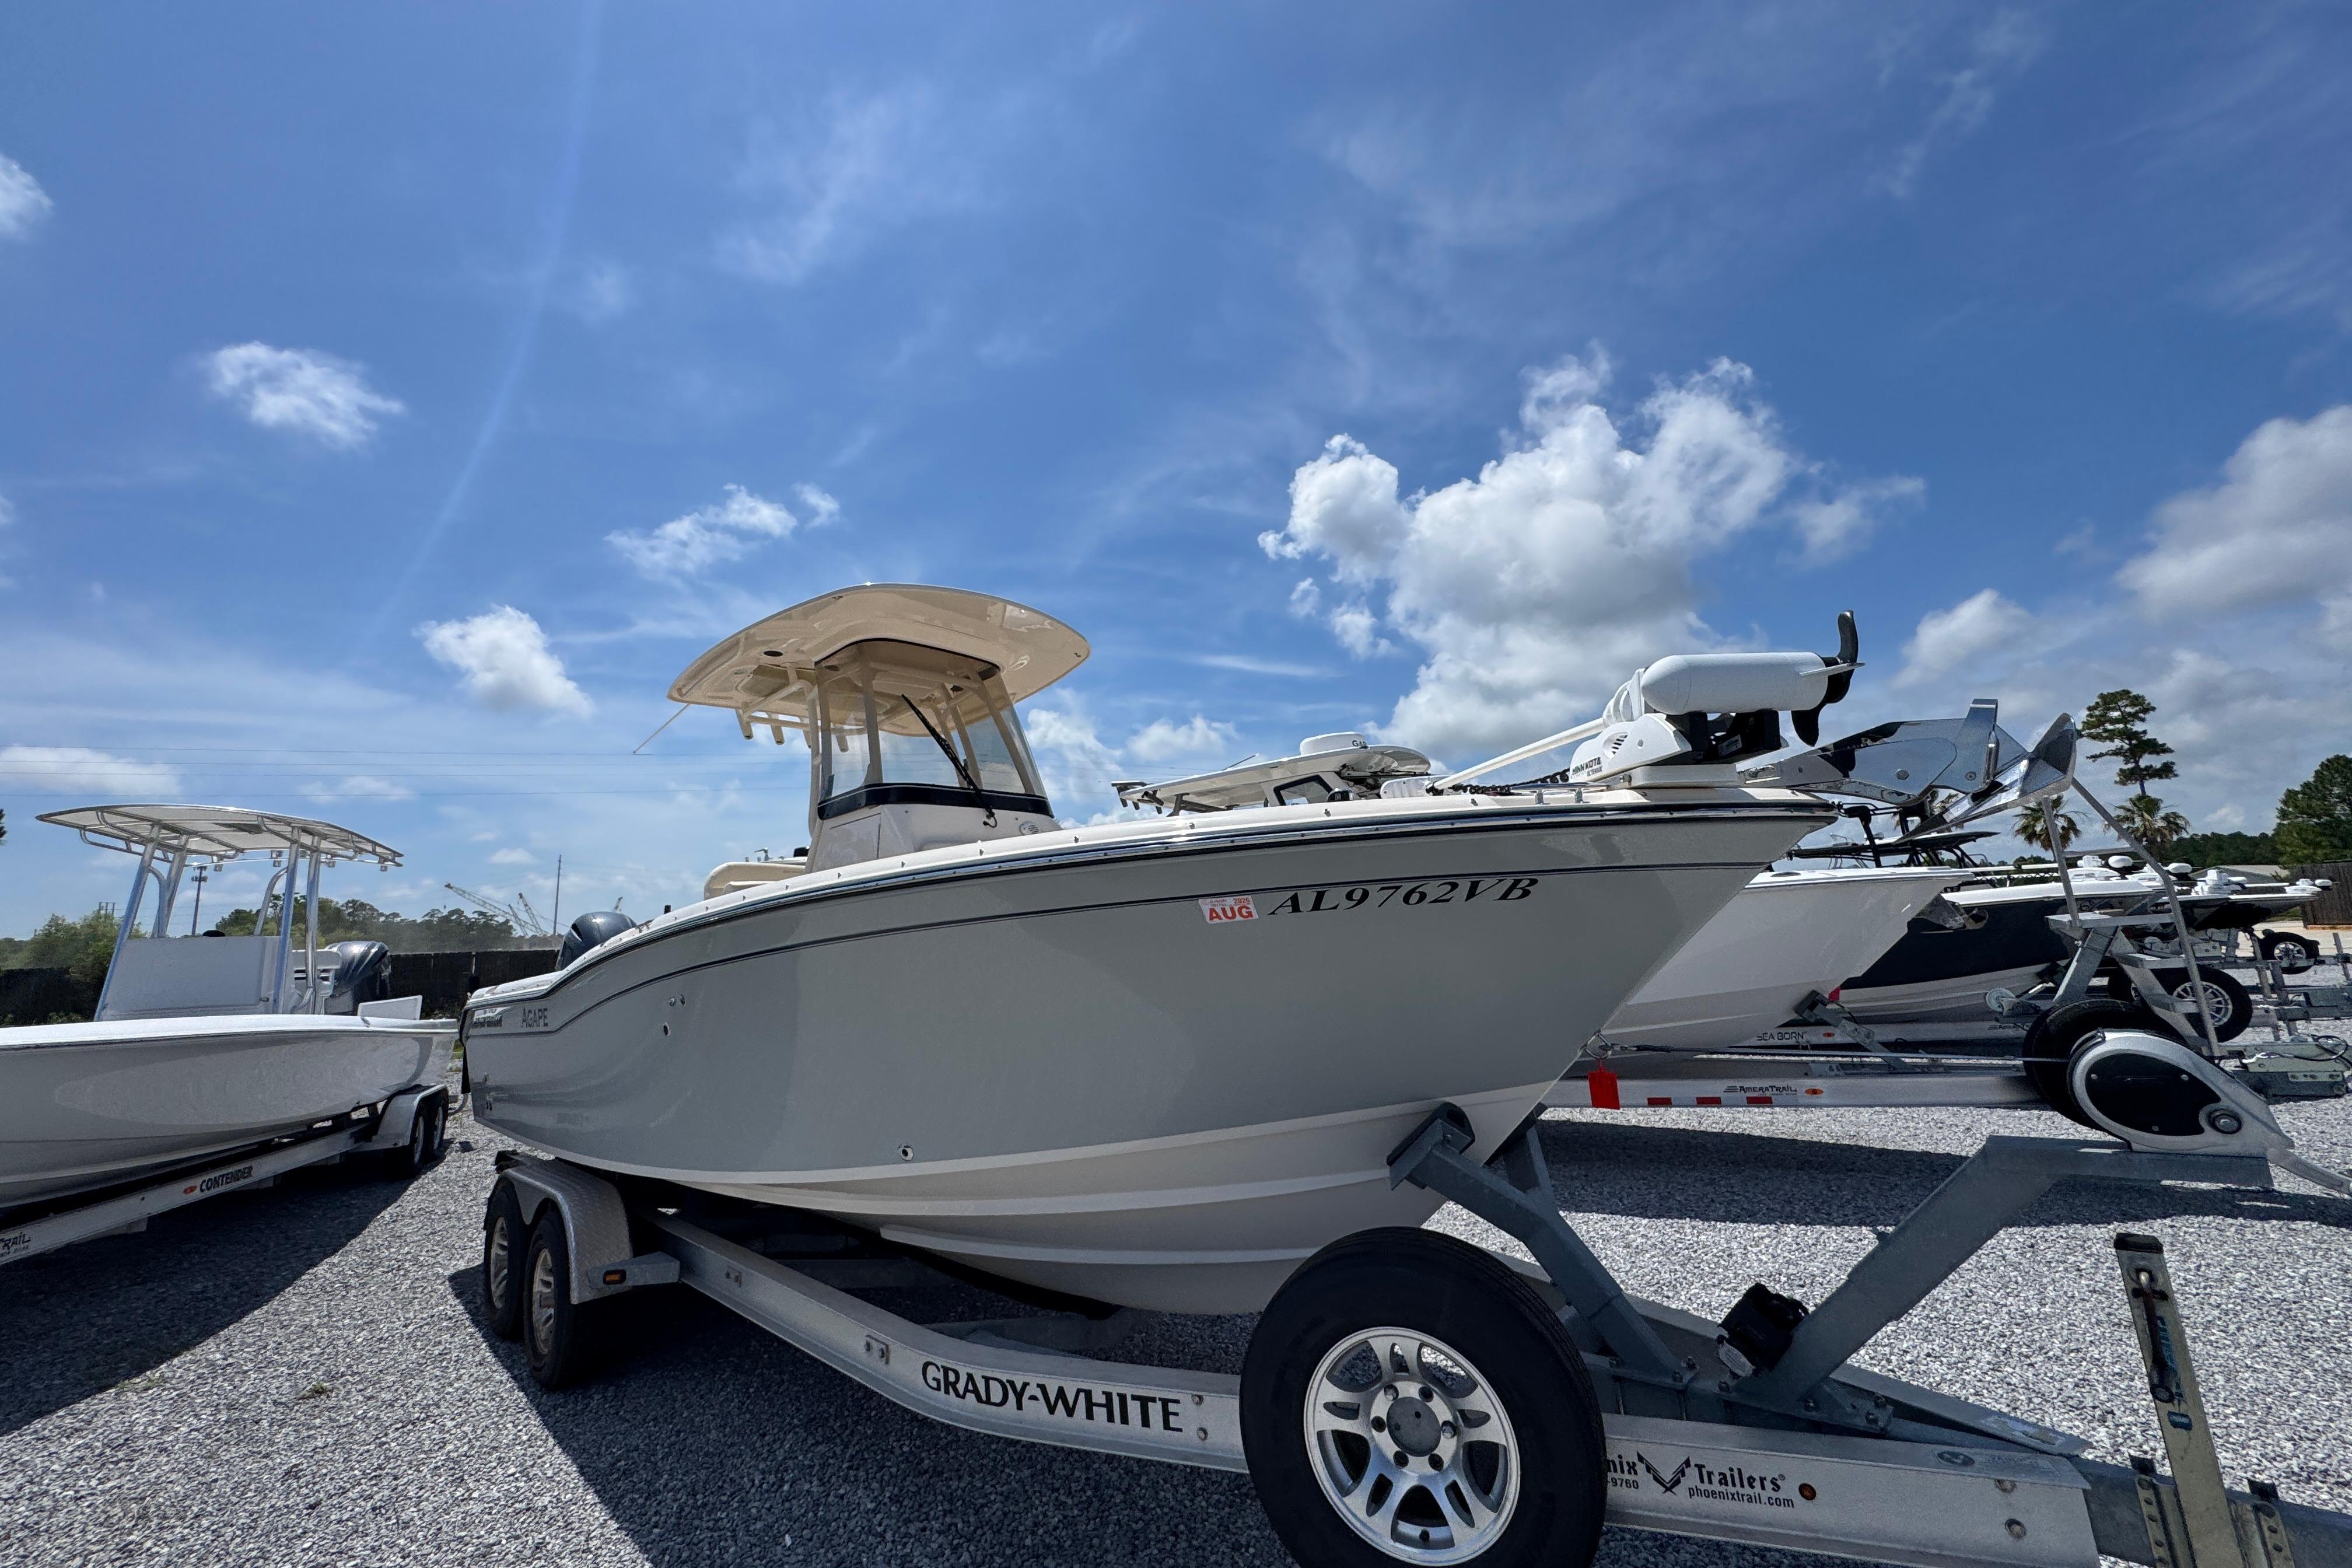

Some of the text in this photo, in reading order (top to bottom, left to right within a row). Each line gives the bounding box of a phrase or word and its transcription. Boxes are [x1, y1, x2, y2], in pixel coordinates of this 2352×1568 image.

[1573, 762, 1585, 775] MINN
[1586, 757, 1601, 770] KOTA
[1267, 878, 1539, 915] AL9762VB
[1209, 905, 1254, 921] AUG
[522, 1006, 549, 1028] AGAPE
[1777, 1031, 1804, 1041] BORN
[200, 1166, 253, 1193] CONTENDER
[922, 1360, 1183, 1433] GRADY-WHITE
[1688, 1485, 1795, 1509] phoenixtrail.com
